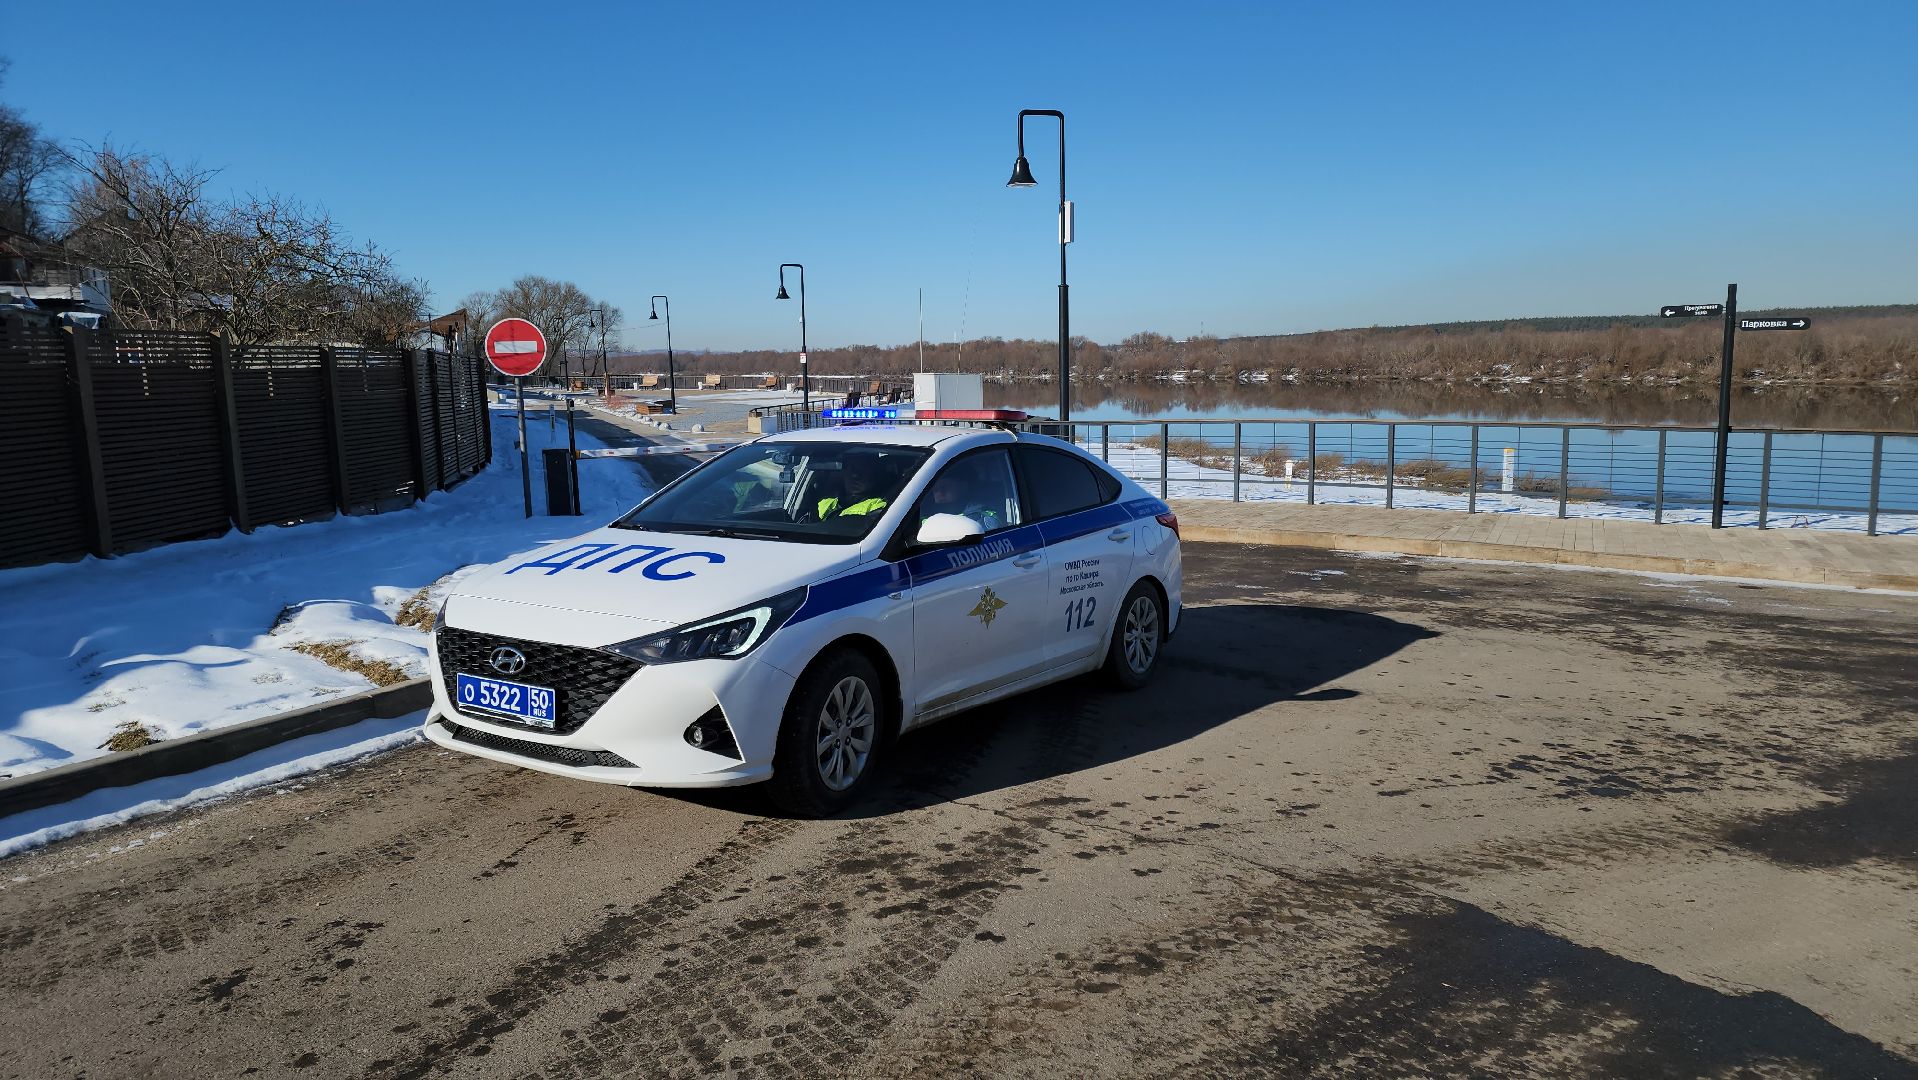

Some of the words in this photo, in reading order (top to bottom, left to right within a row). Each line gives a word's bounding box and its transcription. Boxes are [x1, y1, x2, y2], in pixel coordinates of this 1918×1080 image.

[1741, 320, 1787, 329] Парковка
[504, 543, 726, 581] ДПС
[946, 537, 1015, 569] ПОЛИЦИЯ
[1065, 596, 1097, 633] 112
[480, 681, 521, 712] 5322
[530, 688, 549, 709] 50
[533, 708, 547, 717] RUS
